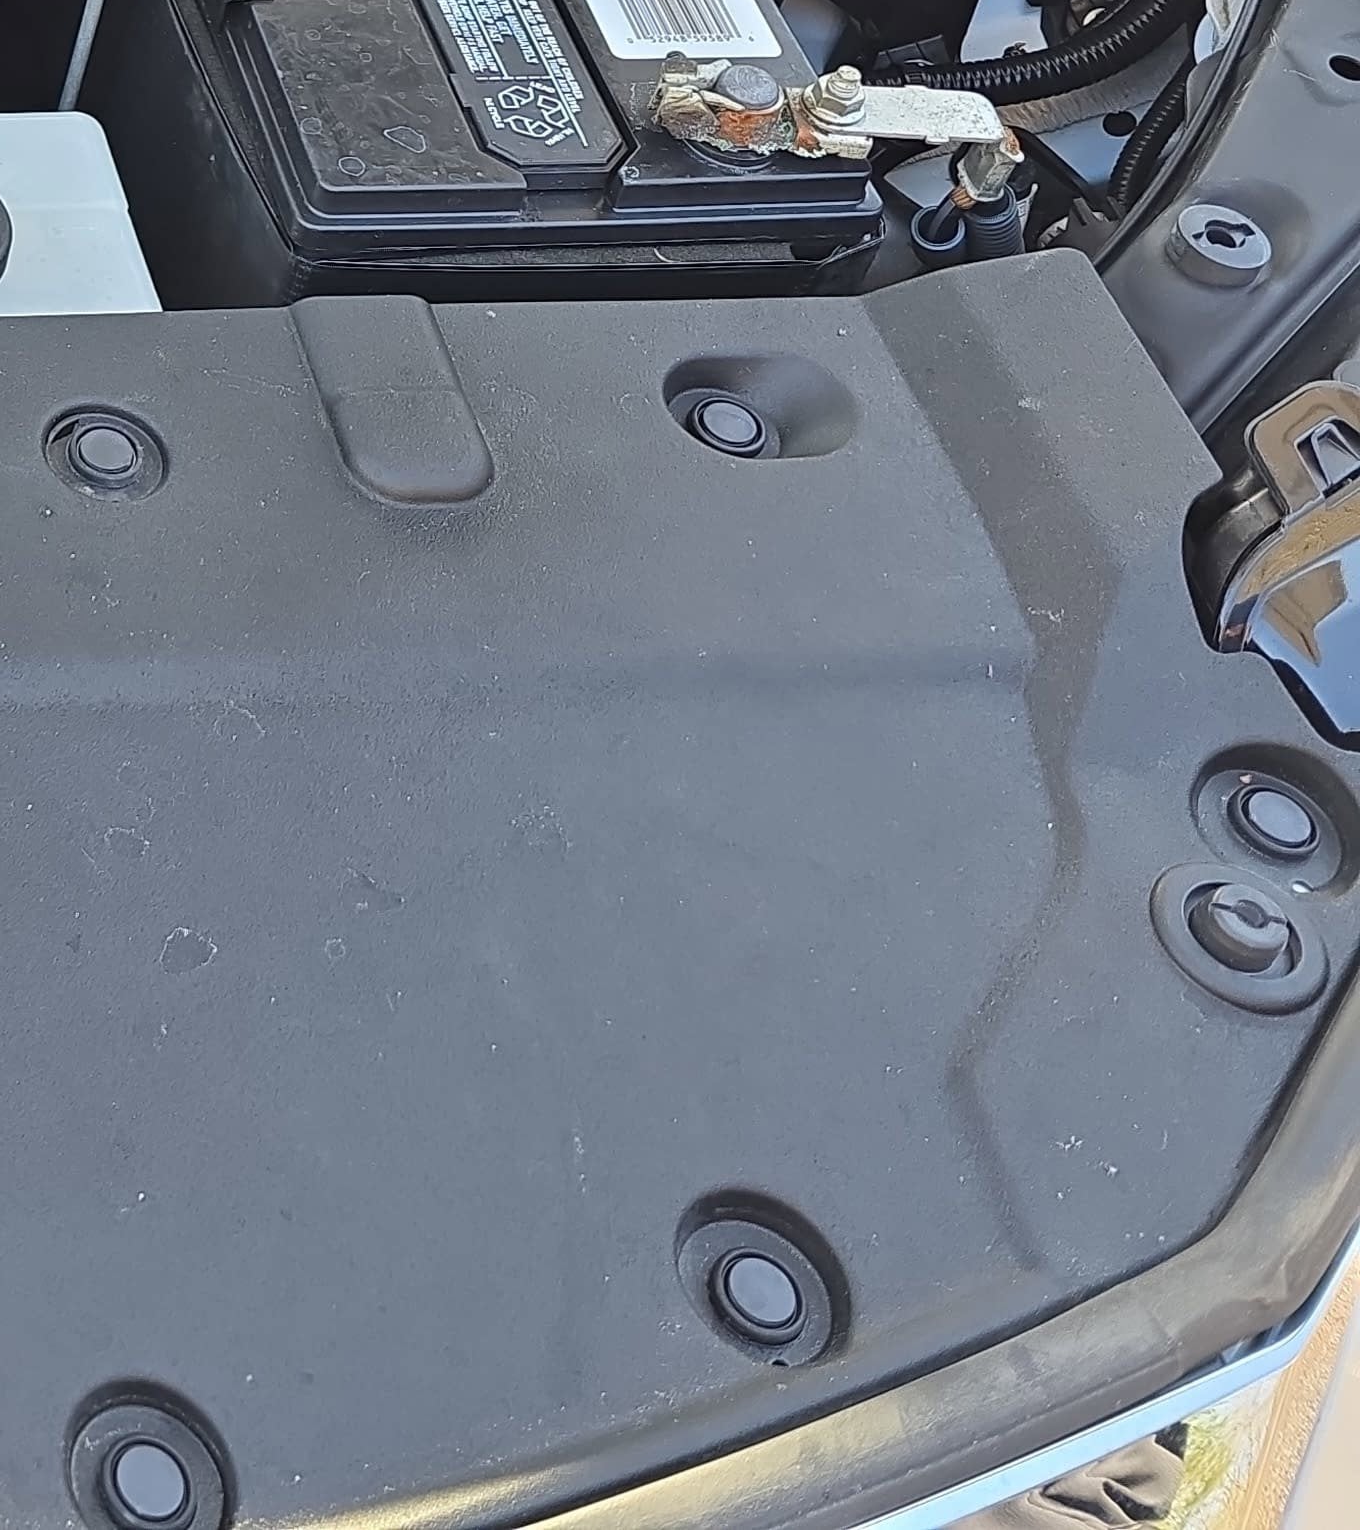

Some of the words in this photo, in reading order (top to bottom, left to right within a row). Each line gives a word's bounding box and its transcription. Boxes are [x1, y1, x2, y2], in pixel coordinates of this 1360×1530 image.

[475, 5, 496, 23] HELP
[485, 24, 505, 43] FAST
[504, 15, 539, 63] IMMEDIATELY
